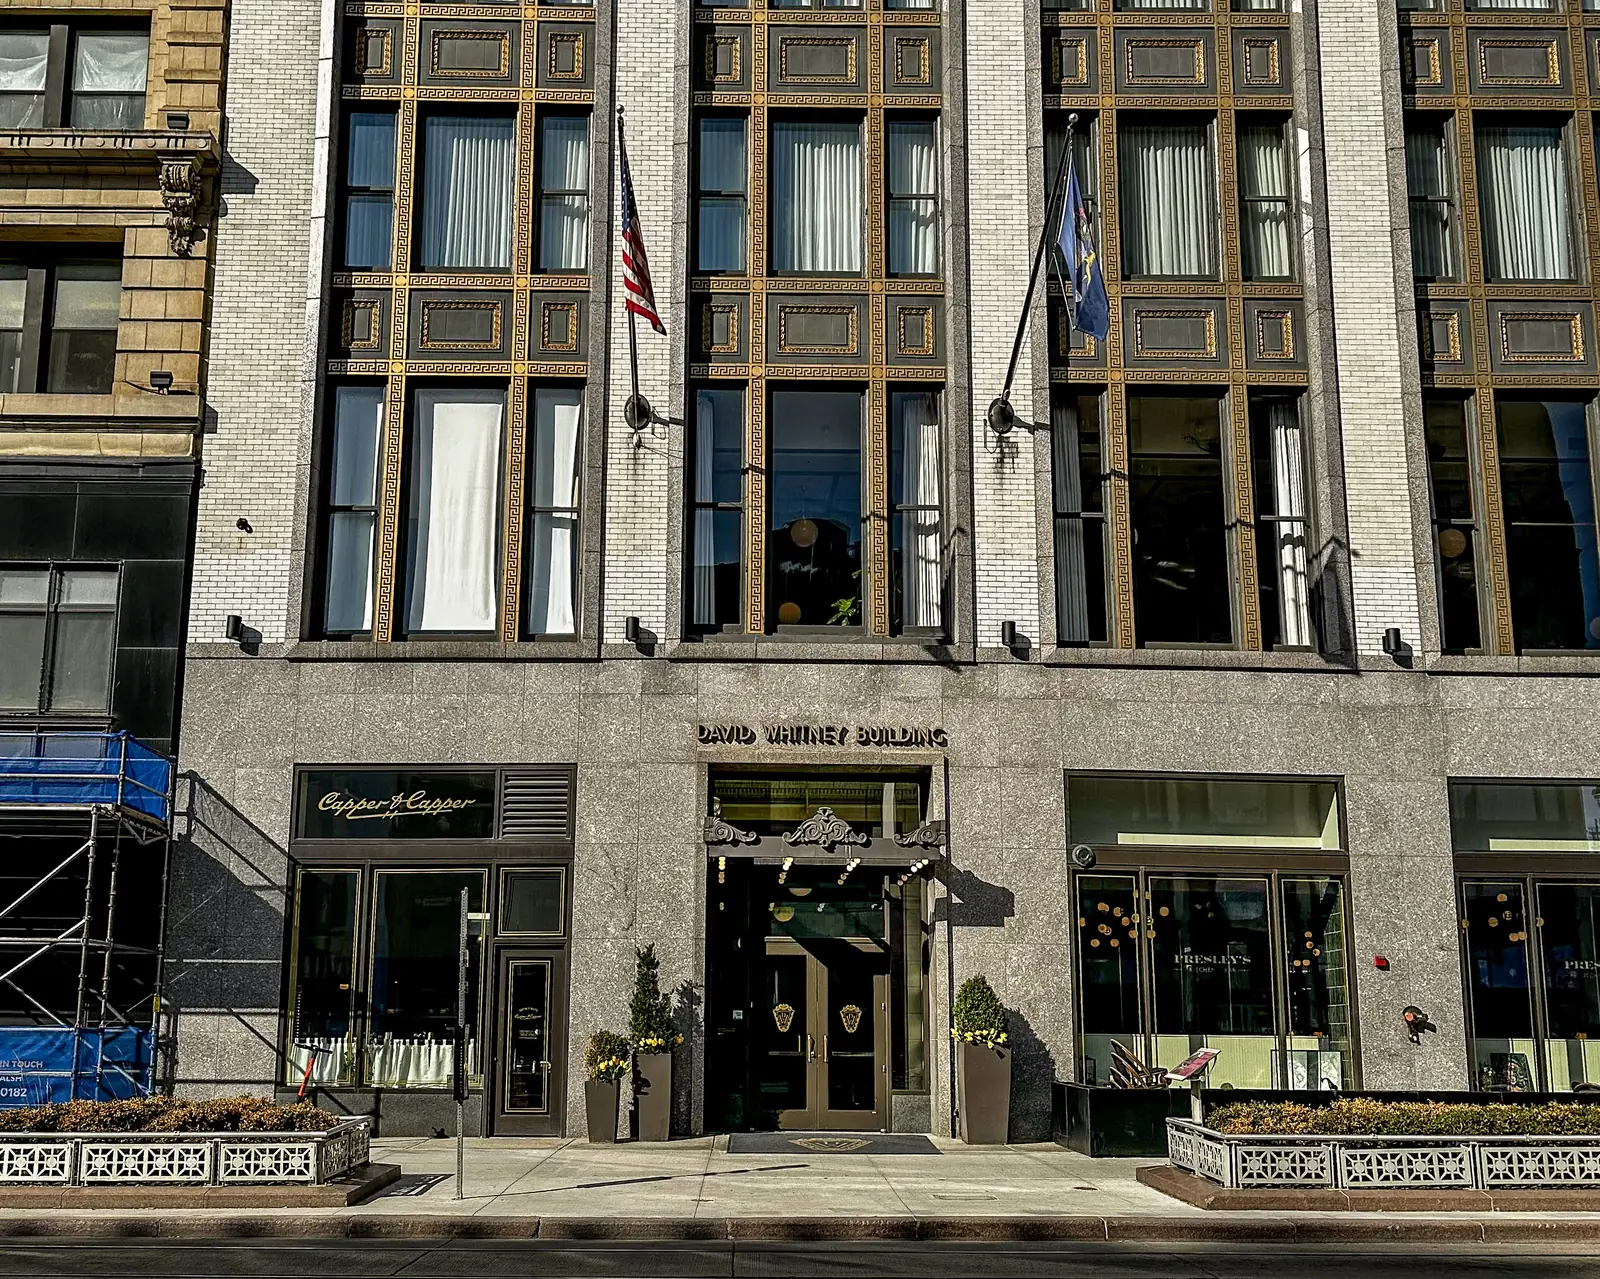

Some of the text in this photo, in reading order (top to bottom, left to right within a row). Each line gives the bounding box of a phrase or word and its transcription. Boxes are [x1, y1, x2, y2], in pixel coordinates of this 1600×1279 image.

[698, 724, 947, 745] DAVID WHITNEY BUILDING
[318, 791, 389, 818] Capper
[406, 790, 476, 815] Capper
[1174, 954, 1251, 965] PRESLEY'S
[12, 1060, 43, 1068] TOUCH
[0, 1087, 27, 1097] 0182
